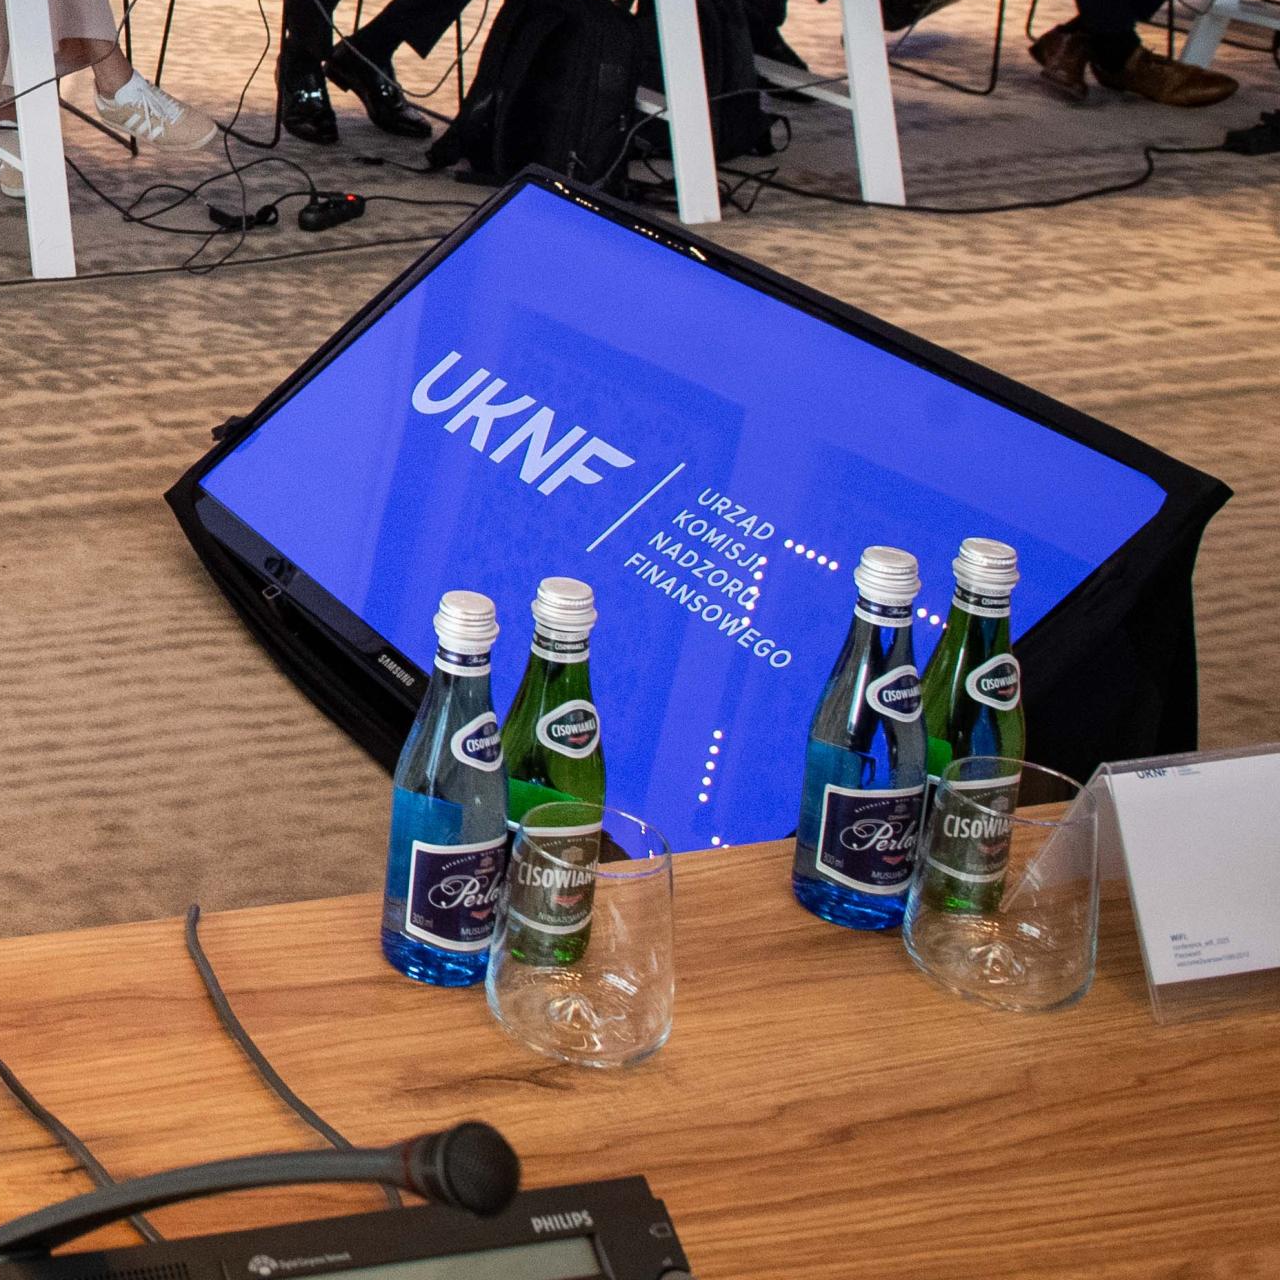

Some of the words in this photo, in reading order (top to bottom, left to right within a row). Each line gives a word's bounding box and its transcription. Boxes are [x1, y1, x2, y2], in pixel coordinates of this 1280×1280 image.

[410, 350, 635, 496] UKNF
[648, 531, 760, 607] NADZORU
[672, 509, 761, 572] KOMISJI
[624, 552, 793, 669] FINANSOWEGO
[377, 654, 415, 687] SAMSUNG
[531, 1209, 594, 1234] PHILIPS
